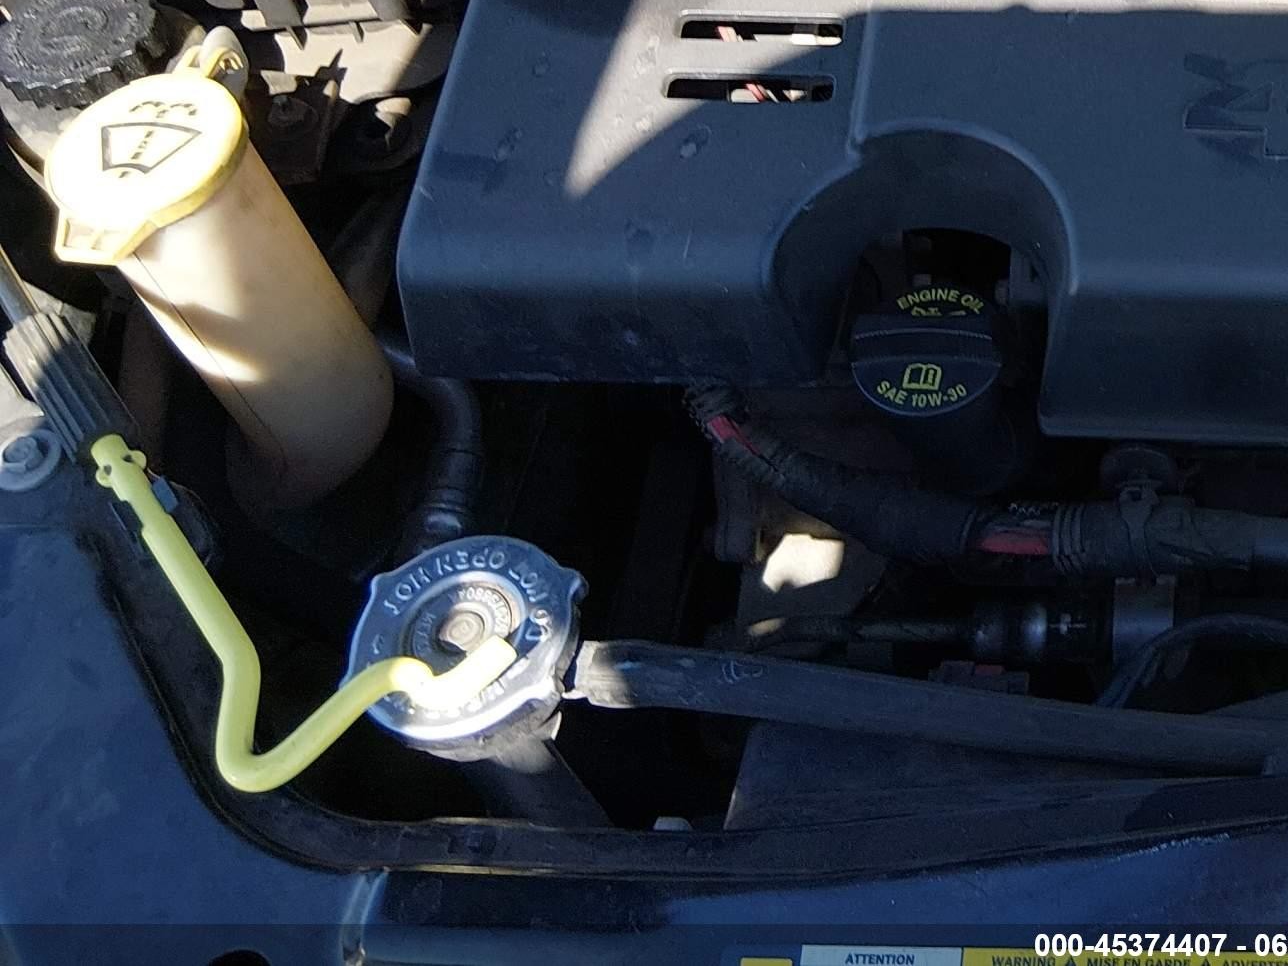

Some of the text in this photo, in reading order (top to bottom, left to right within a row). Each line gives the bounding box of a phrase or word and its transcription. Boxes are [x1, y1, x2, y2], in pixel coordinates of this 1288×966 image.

[896, 288, 985, 314] ENGINE OIL
[876, 380, 967, 408] SAE 10W-30
[845, 953, 916, 966] ATTENTION
[991, 955, 1057, 966] WARNING
